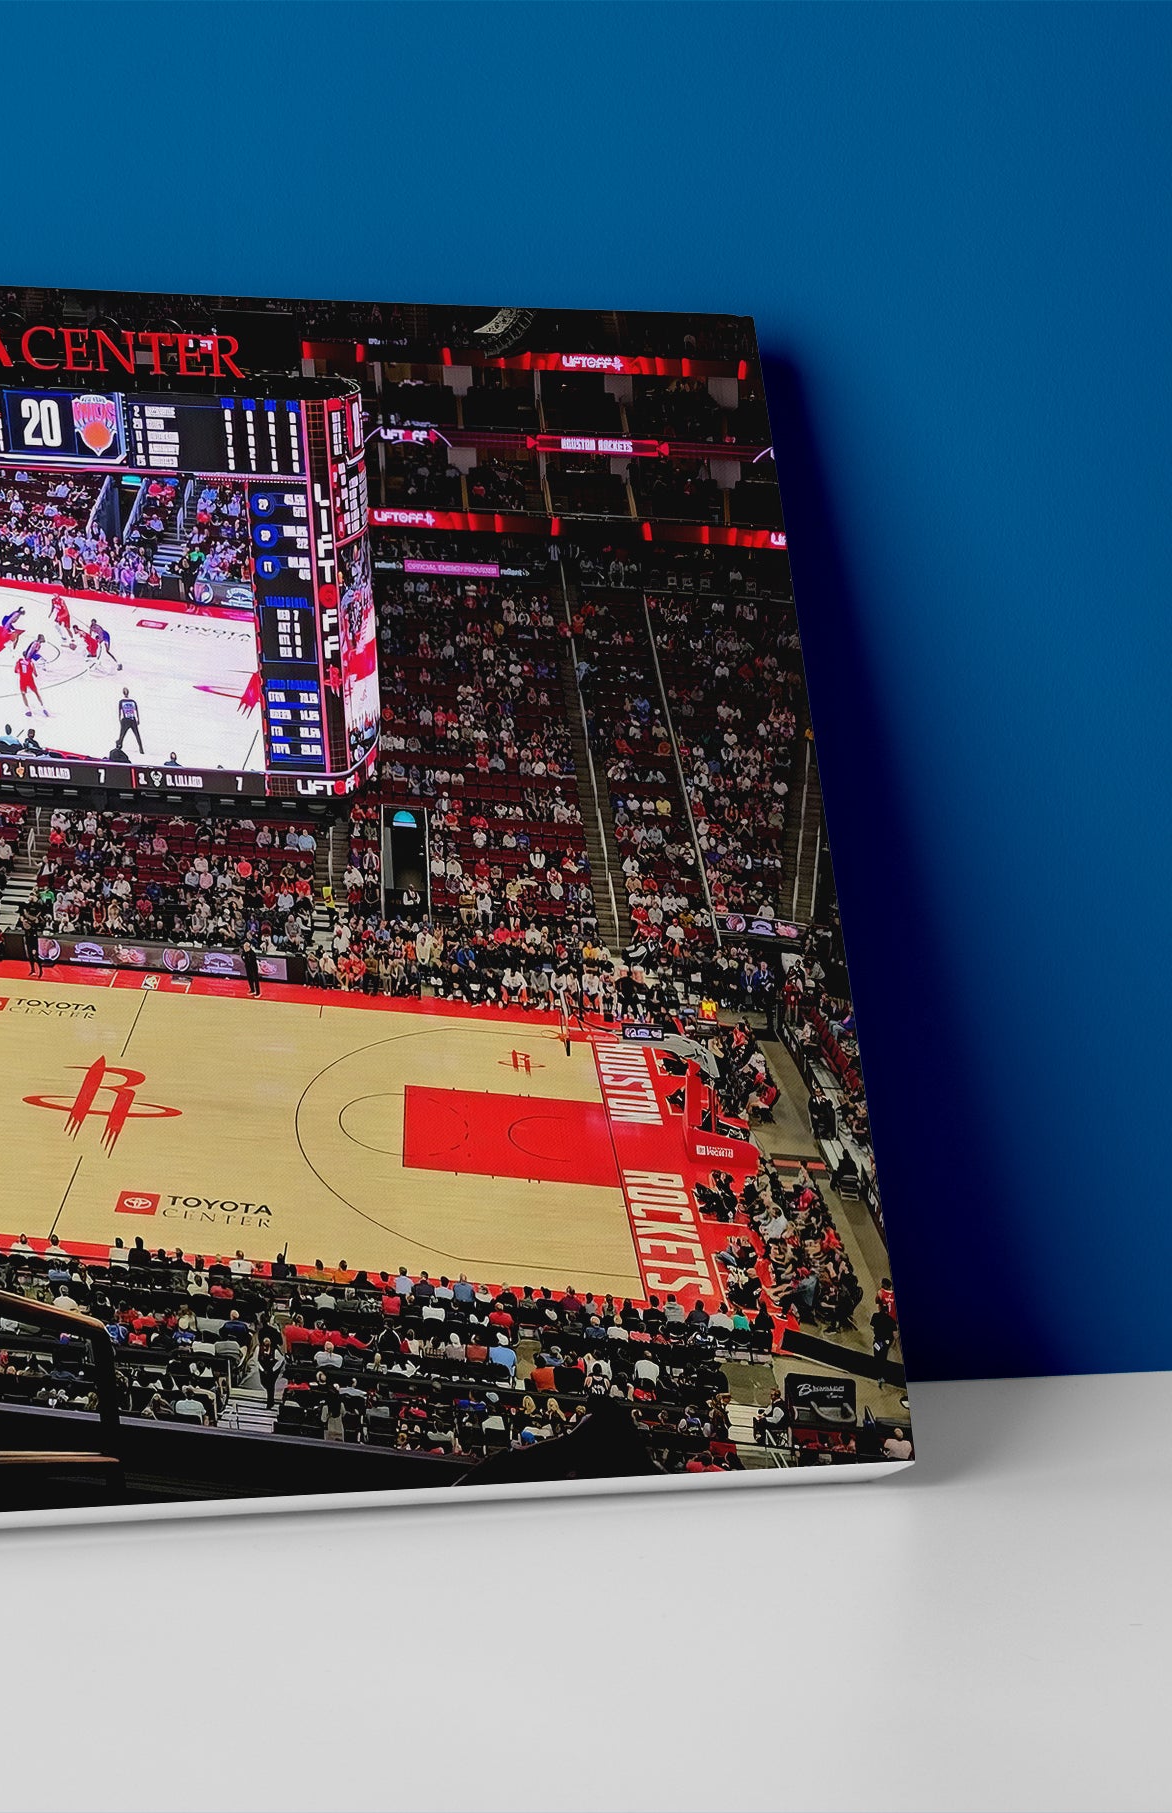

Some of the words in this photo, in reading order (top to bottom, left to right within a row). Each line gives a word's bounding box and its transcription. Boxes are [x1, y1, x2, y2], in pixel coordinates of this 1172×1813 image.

[21, 325, 246, 379] CENTER
[20, 398, 63, 448] 20
[16, 997, 97, 1012] TOYOTA
[595, 1042, 664, 1126] HOUSTON
[163, 1208, 270, 1229] CENTER
[167, 1195, 273, 1216] TOYOTA
[622, 1169, 715, 1296] ROCKETS
